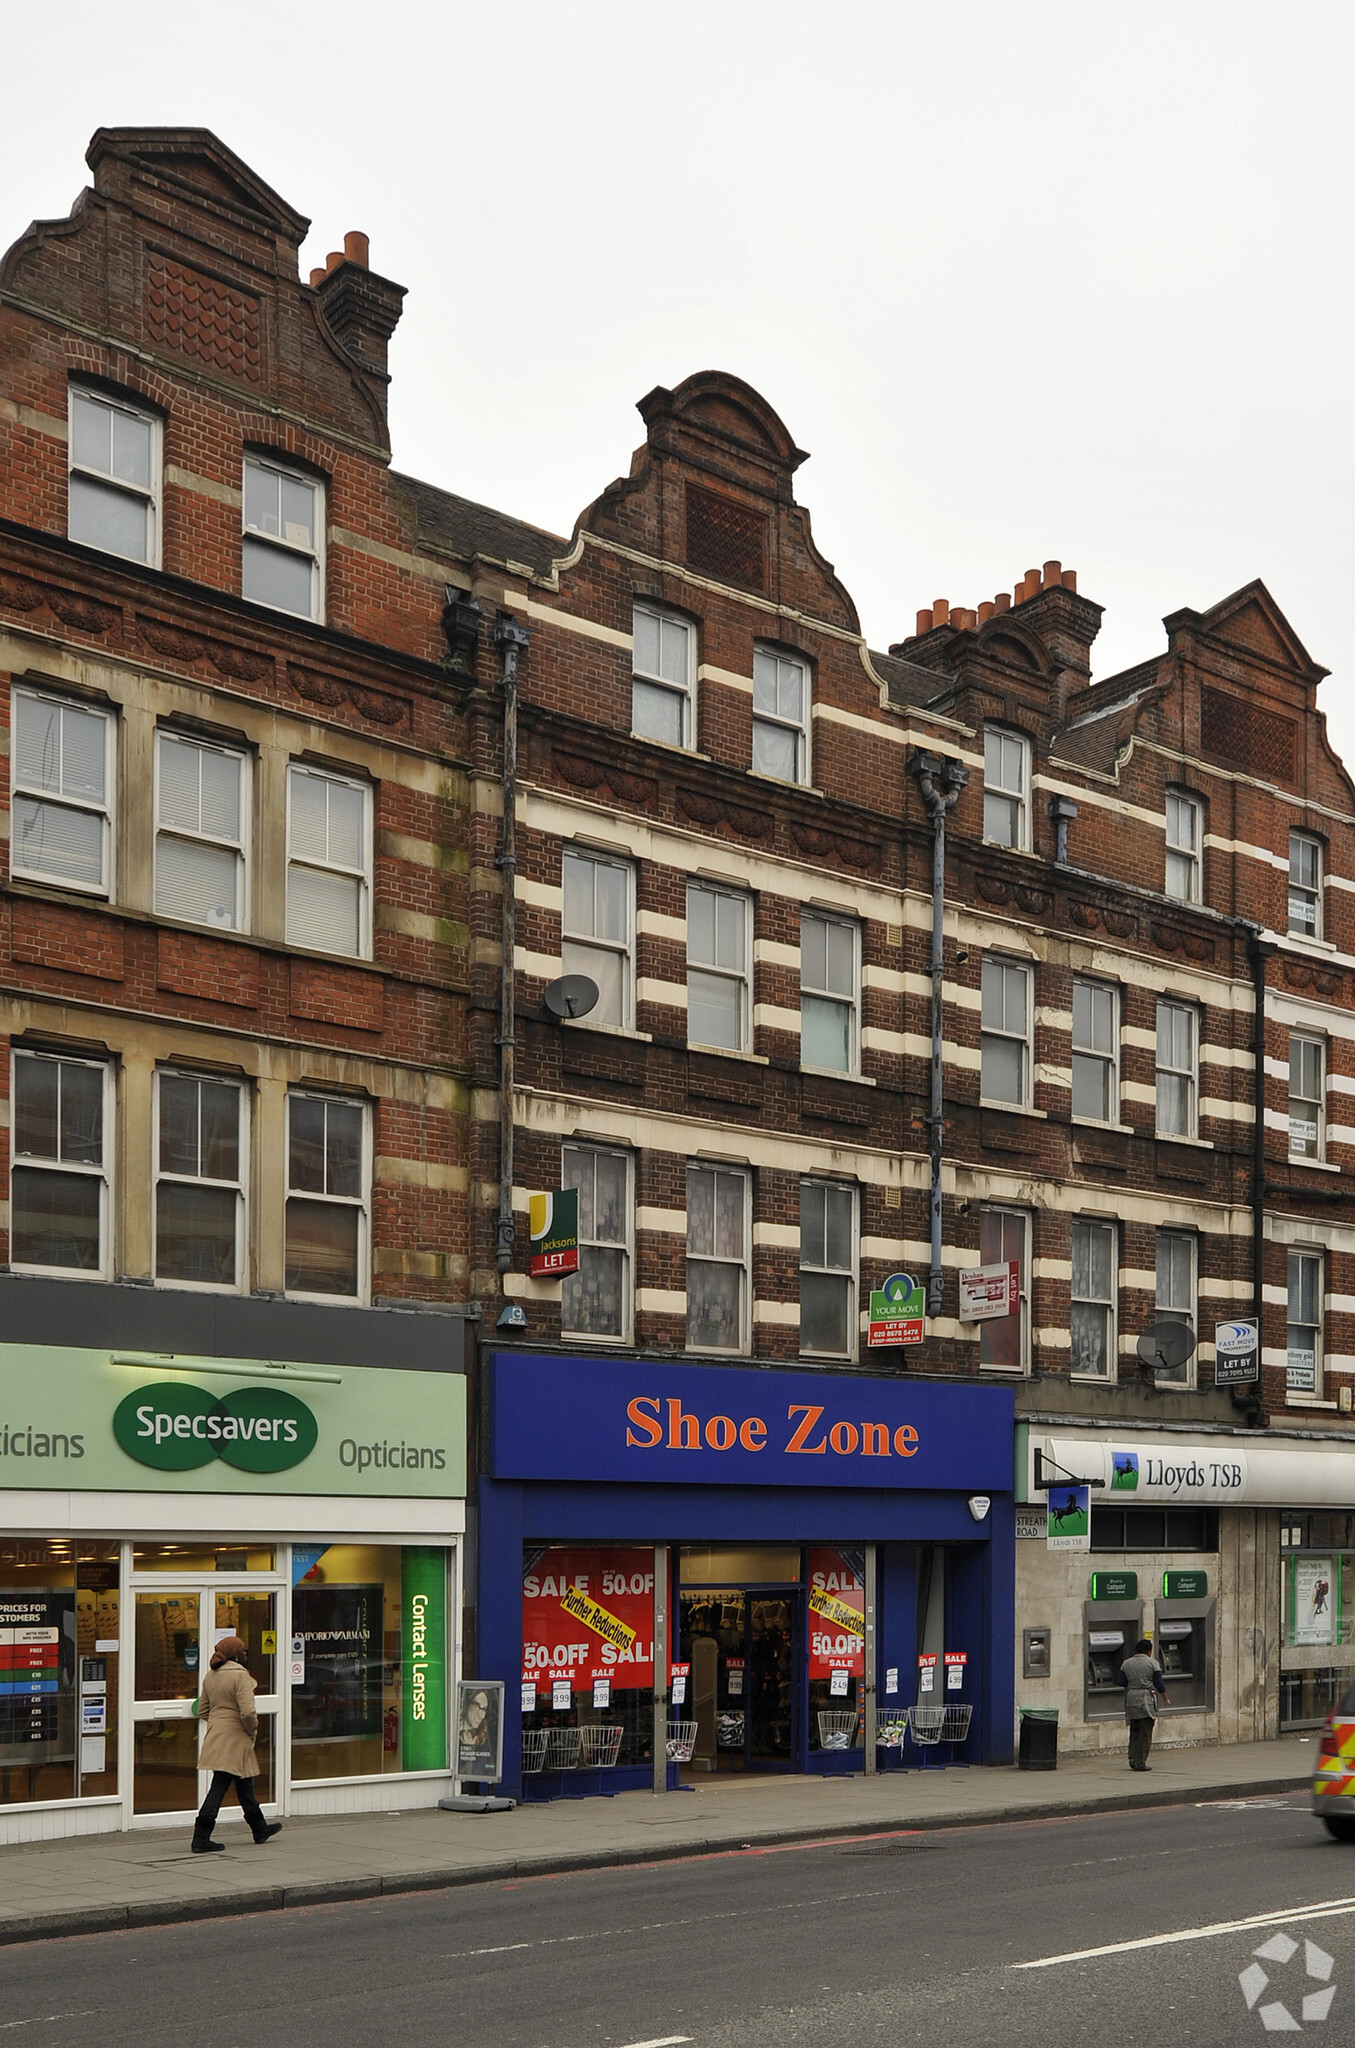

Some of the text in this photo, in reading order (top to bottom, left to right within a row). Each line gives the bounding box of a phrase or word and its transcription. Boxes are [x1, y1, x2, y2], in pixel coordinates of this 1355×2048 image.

[541, 1237, 576, 1253] Jacksons
[544, 1253, 564, 1268] LET
[1009, 1273, 1018, 1302] Let by
[875, 1305, 919, 1315] YOUR MOVE
[1224, 1358, 1251, 1369] LET BY
[136, 1406, 298, 1445] Specsavers
[626, 1397, 919, 1458] Shoe Zone
[339, 1438, 446, 1473] Opticians
[1146, 1459, 1242, 1494] Lloyds TSB
[1017, 1516, 1047, 1526] STREATH
[1016, 1527, 1038, 1537] ROAD
[1053, 1538, 1083, 1548] Lloyds TSB
[523, 1575, 589, 1598] SALE
[810, 1588, 833, 1615] Further
[0, 1603, 47, 1612] PRICES FOR
[0, 1613, 40, 1622] STOMERS
[562, 1587, 633, 1650] Further Reductions
[295, 1630, 370, 1641] EMPORIO ARMANI
[412, 1594, 429, 1720] Contact Lenses
[601, 1641, 654, 1664] SAL
[828, 1659, 854, 1667] SALE
[945, 1655, 966, 1663] SALE
[522, 1671, 540, 1680] ALE
[549, 1669, 575, 1679] SALE
[591, 1668, 615, 1677] SALE
